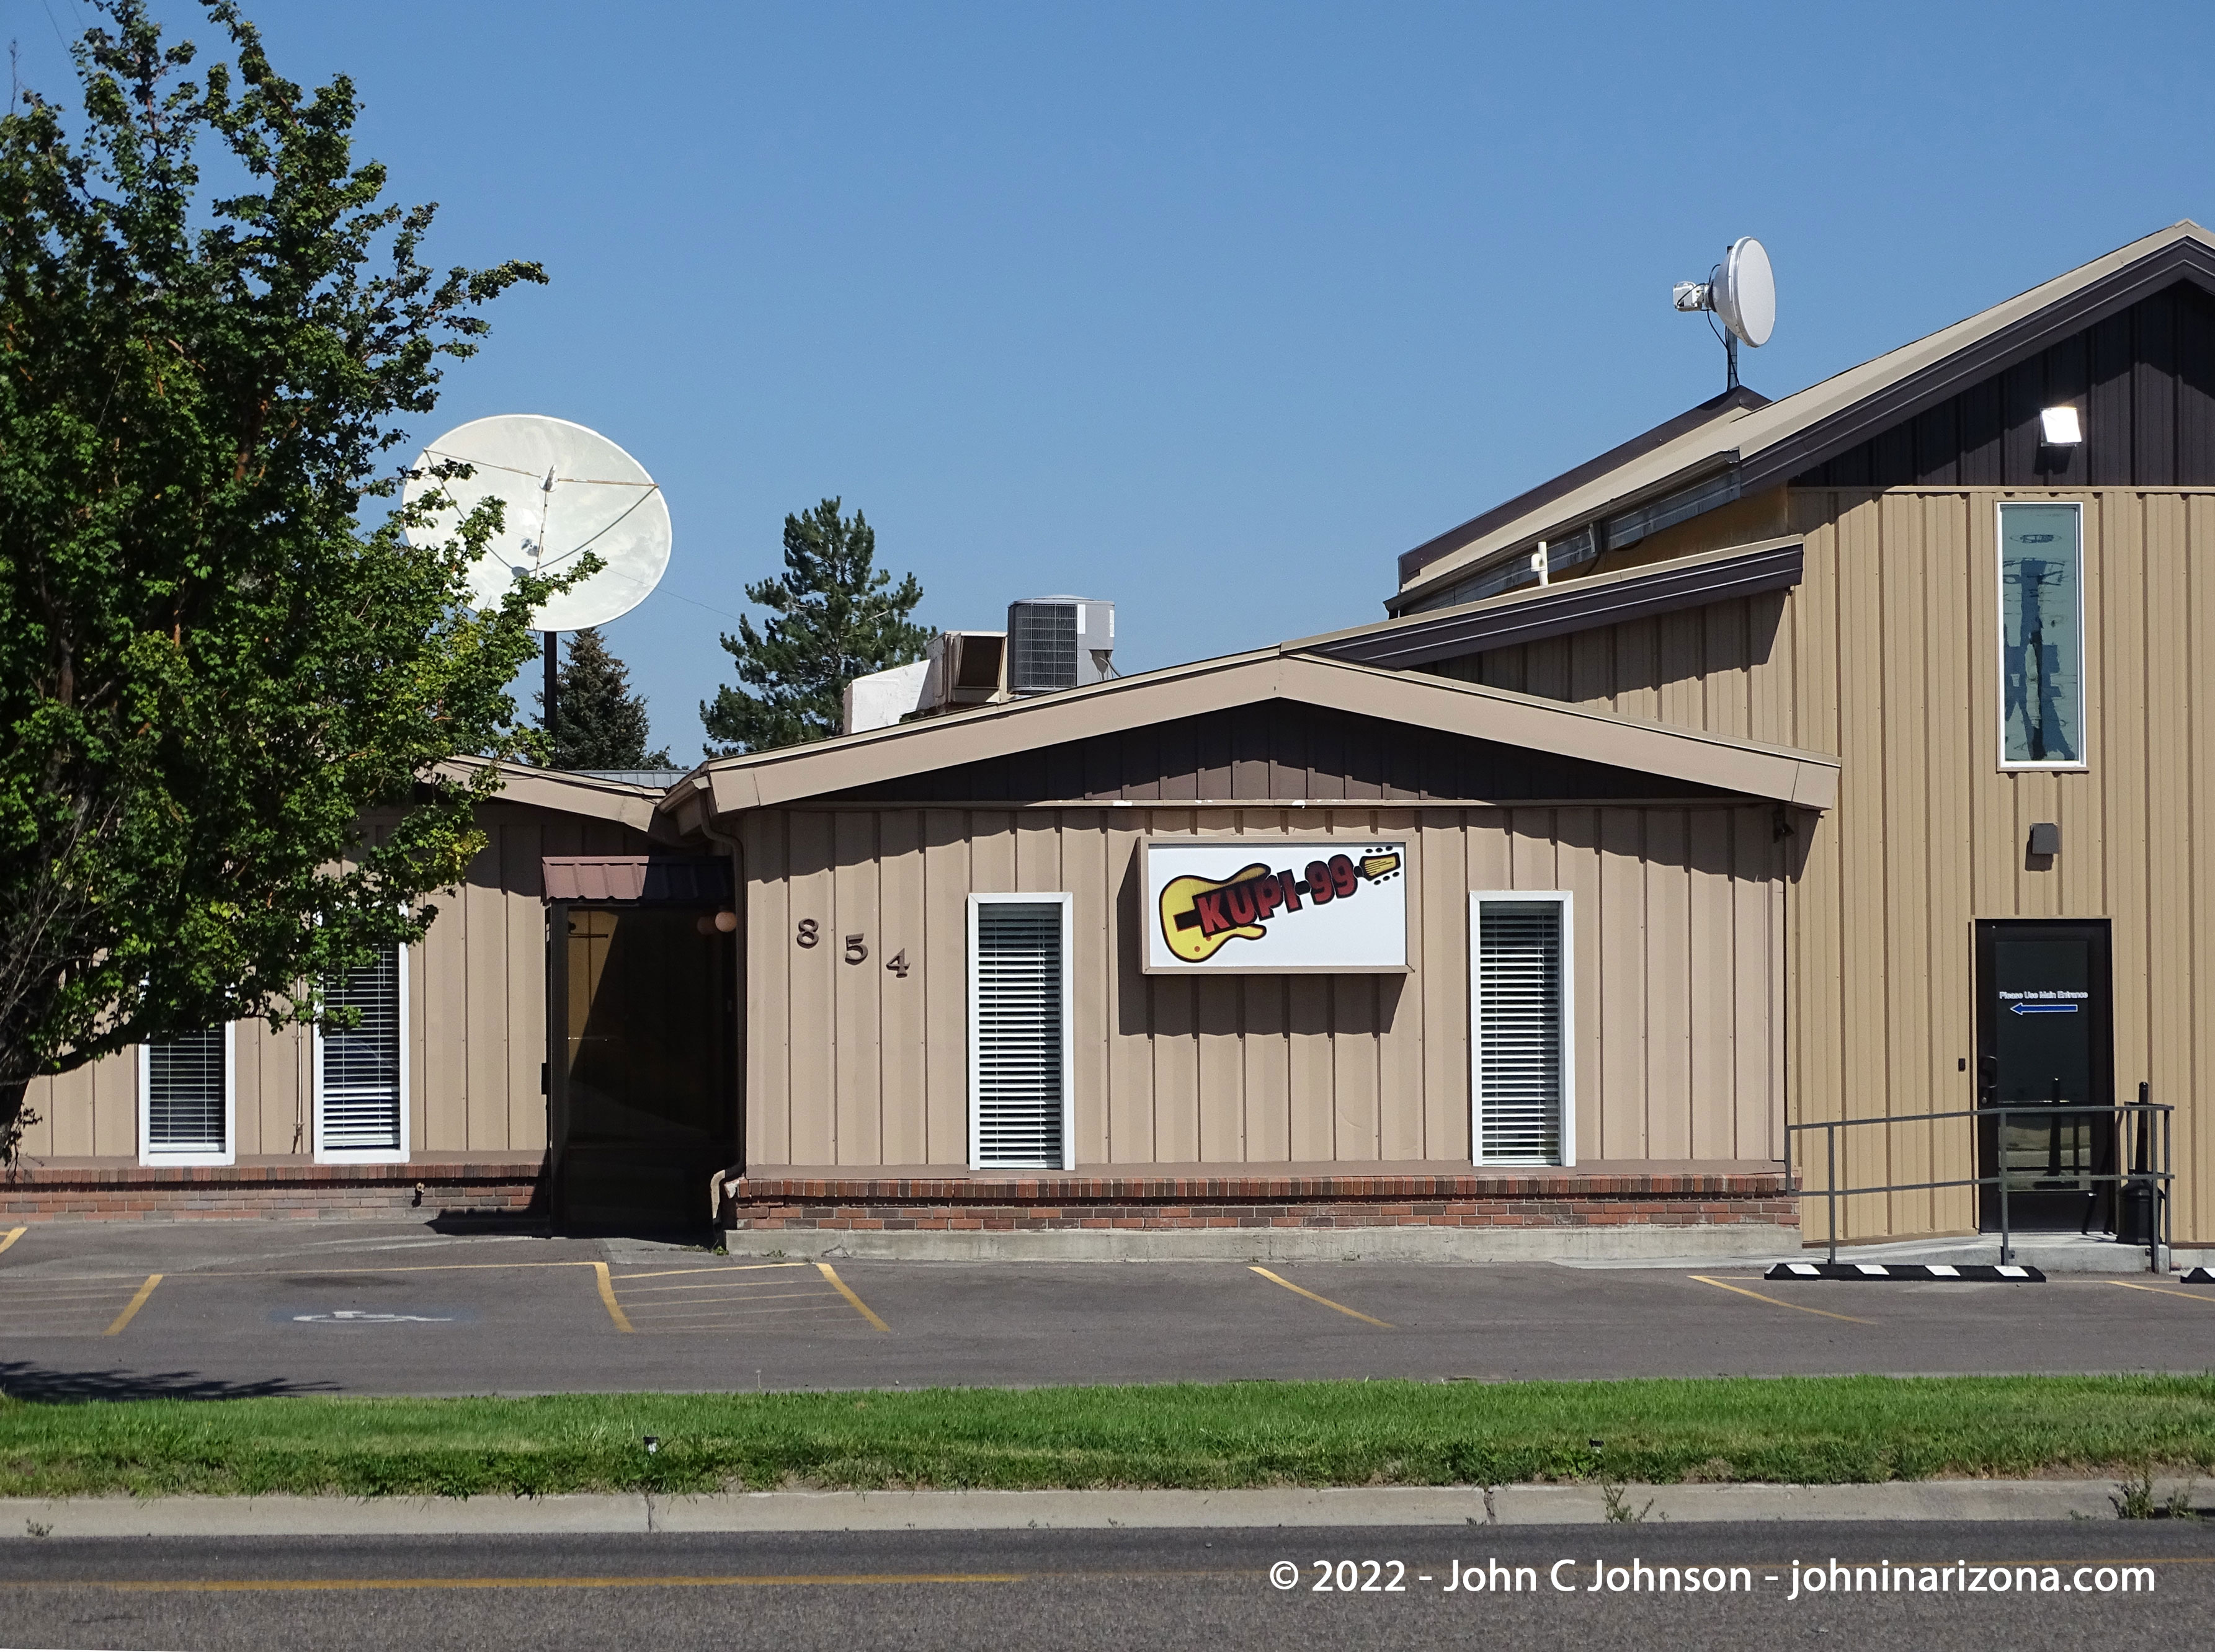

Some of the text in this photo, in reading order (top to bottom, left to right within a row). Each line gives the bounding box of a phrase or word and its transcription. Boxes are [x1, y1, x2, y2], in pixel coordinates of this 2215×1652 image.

[1192, 853, 1358, 938] KUPI-99
[796, 918, 911, 979] 854
[1999, 991, 2023, 999] Please
[2024, 991, 2038, 999] Use
[2057, 990, 2088, 998] Entrance
